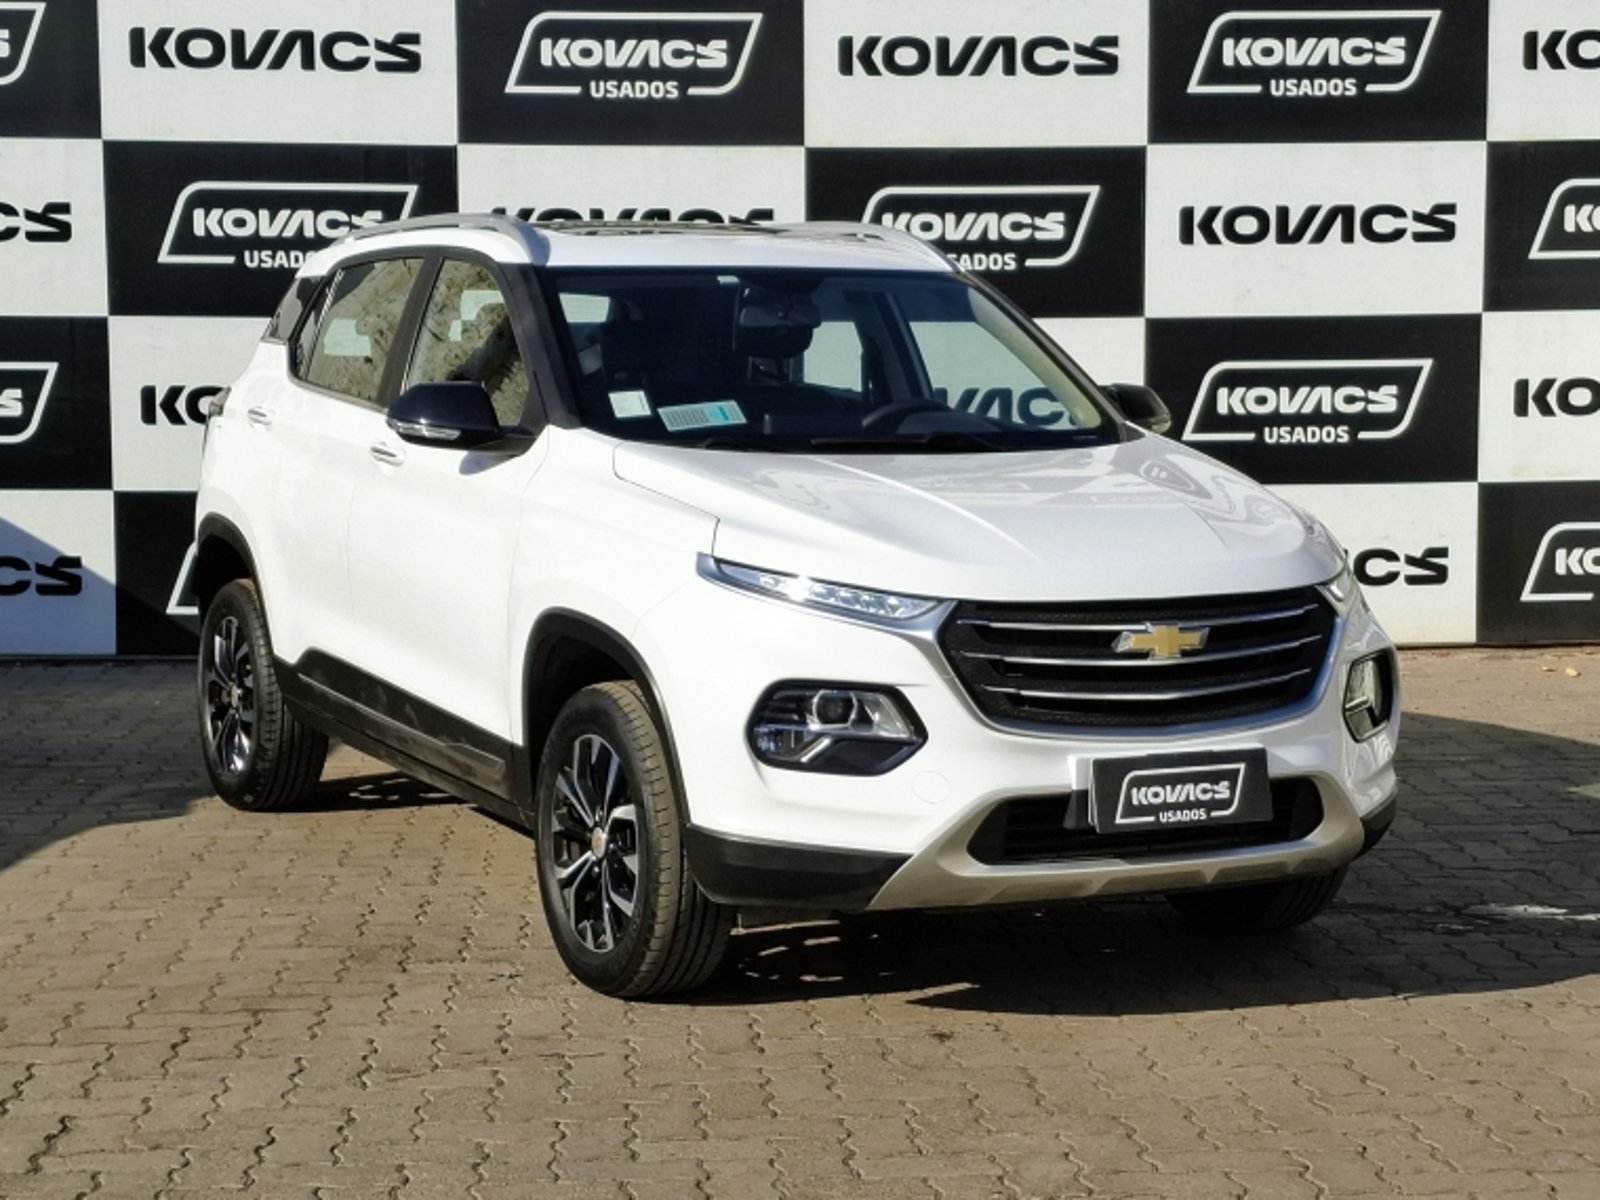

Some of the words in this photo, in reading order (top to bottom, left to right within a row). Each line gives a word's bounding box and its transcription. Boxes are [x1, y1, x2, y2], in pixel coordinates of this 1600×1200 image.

[128, 27, 422, 74] KOVACS
[540, 38, 728, 69] KOVACS
[838, 36, 1119, 76] KOVACS
[1222, 37, 1406, 67] KOVACS
[589, 81, 679, 99] USADOS
[1270, 78, 1357, 97] USADOS
[1179, 203, 1457, 245] KOVACS
[1216, 384, 1399, 415] KOVACS
[1263, 426, 1350, 444] USADOS
[1344, 547, 1449, 586] CS
[1131, 781, 1230, 805] KOVACS
[1158, 808, 1208, 824] USADOS
